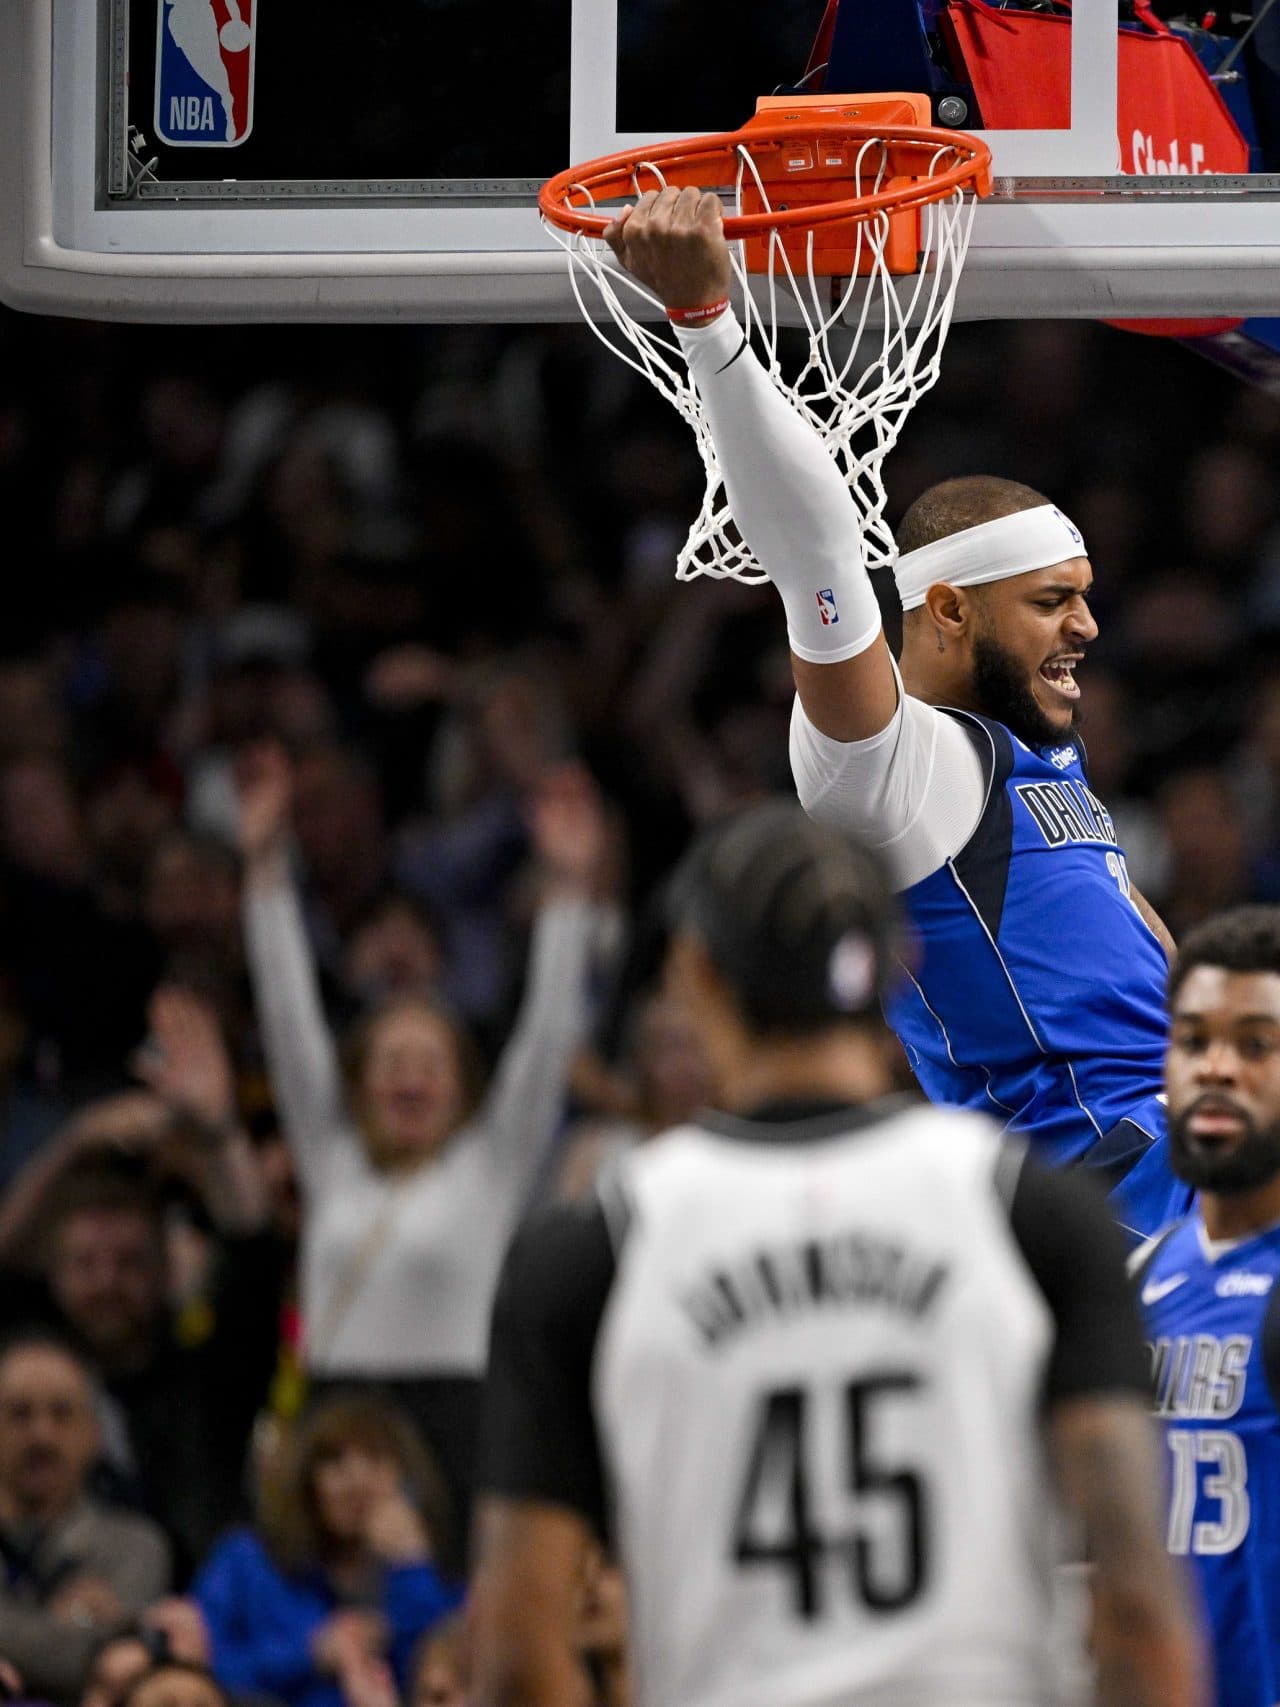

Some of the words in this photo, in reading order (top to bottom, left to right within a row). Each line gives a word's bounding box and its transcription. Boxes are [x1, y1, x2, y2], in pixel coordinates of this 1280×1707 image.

[169, 96, 215, 131] NBA
[731, 1368, 930, 1626] 45
[1166, 1429, 1251, 1555] 13
